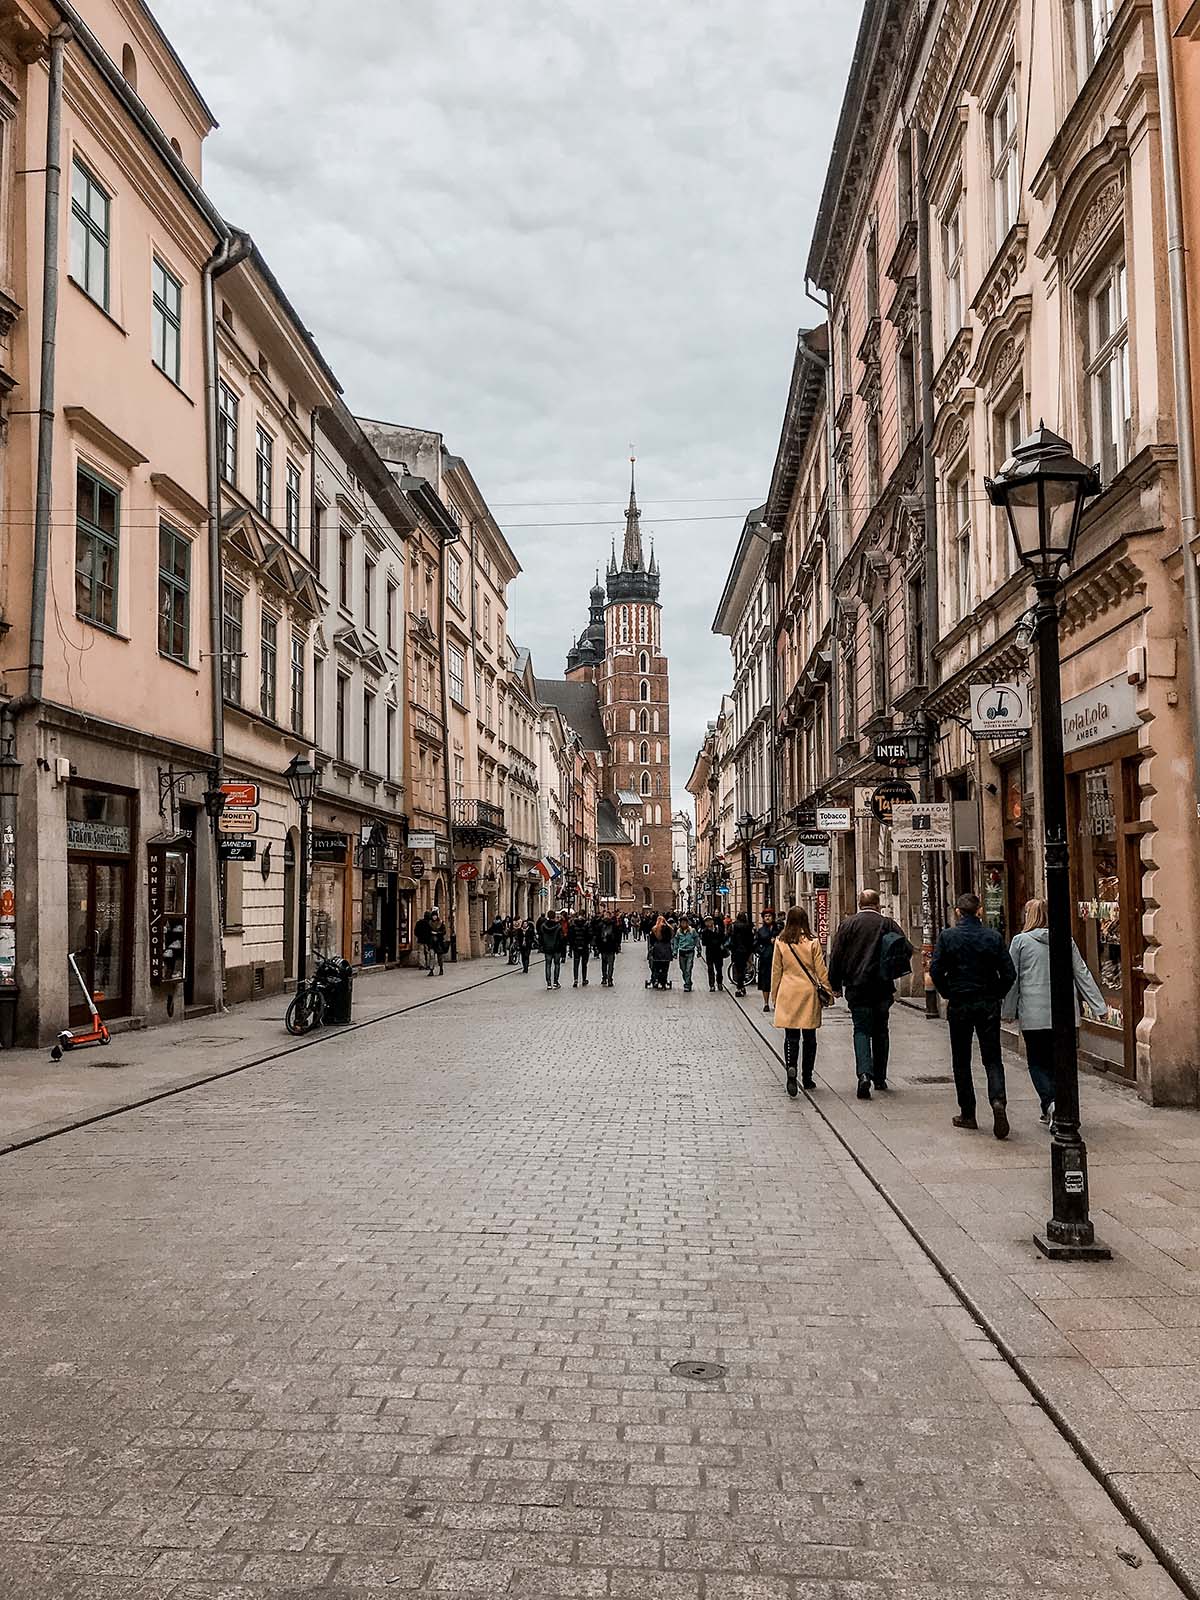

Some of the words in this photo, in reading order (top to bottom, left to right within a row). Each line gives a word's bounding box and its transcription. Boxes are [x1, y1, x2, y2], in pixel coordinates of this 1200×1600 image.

[1076, 726, 1098, 741] AMBER
[820, 812, 847, 820] Tobacco
[818, 894, 828, 945] EXCHANGE
